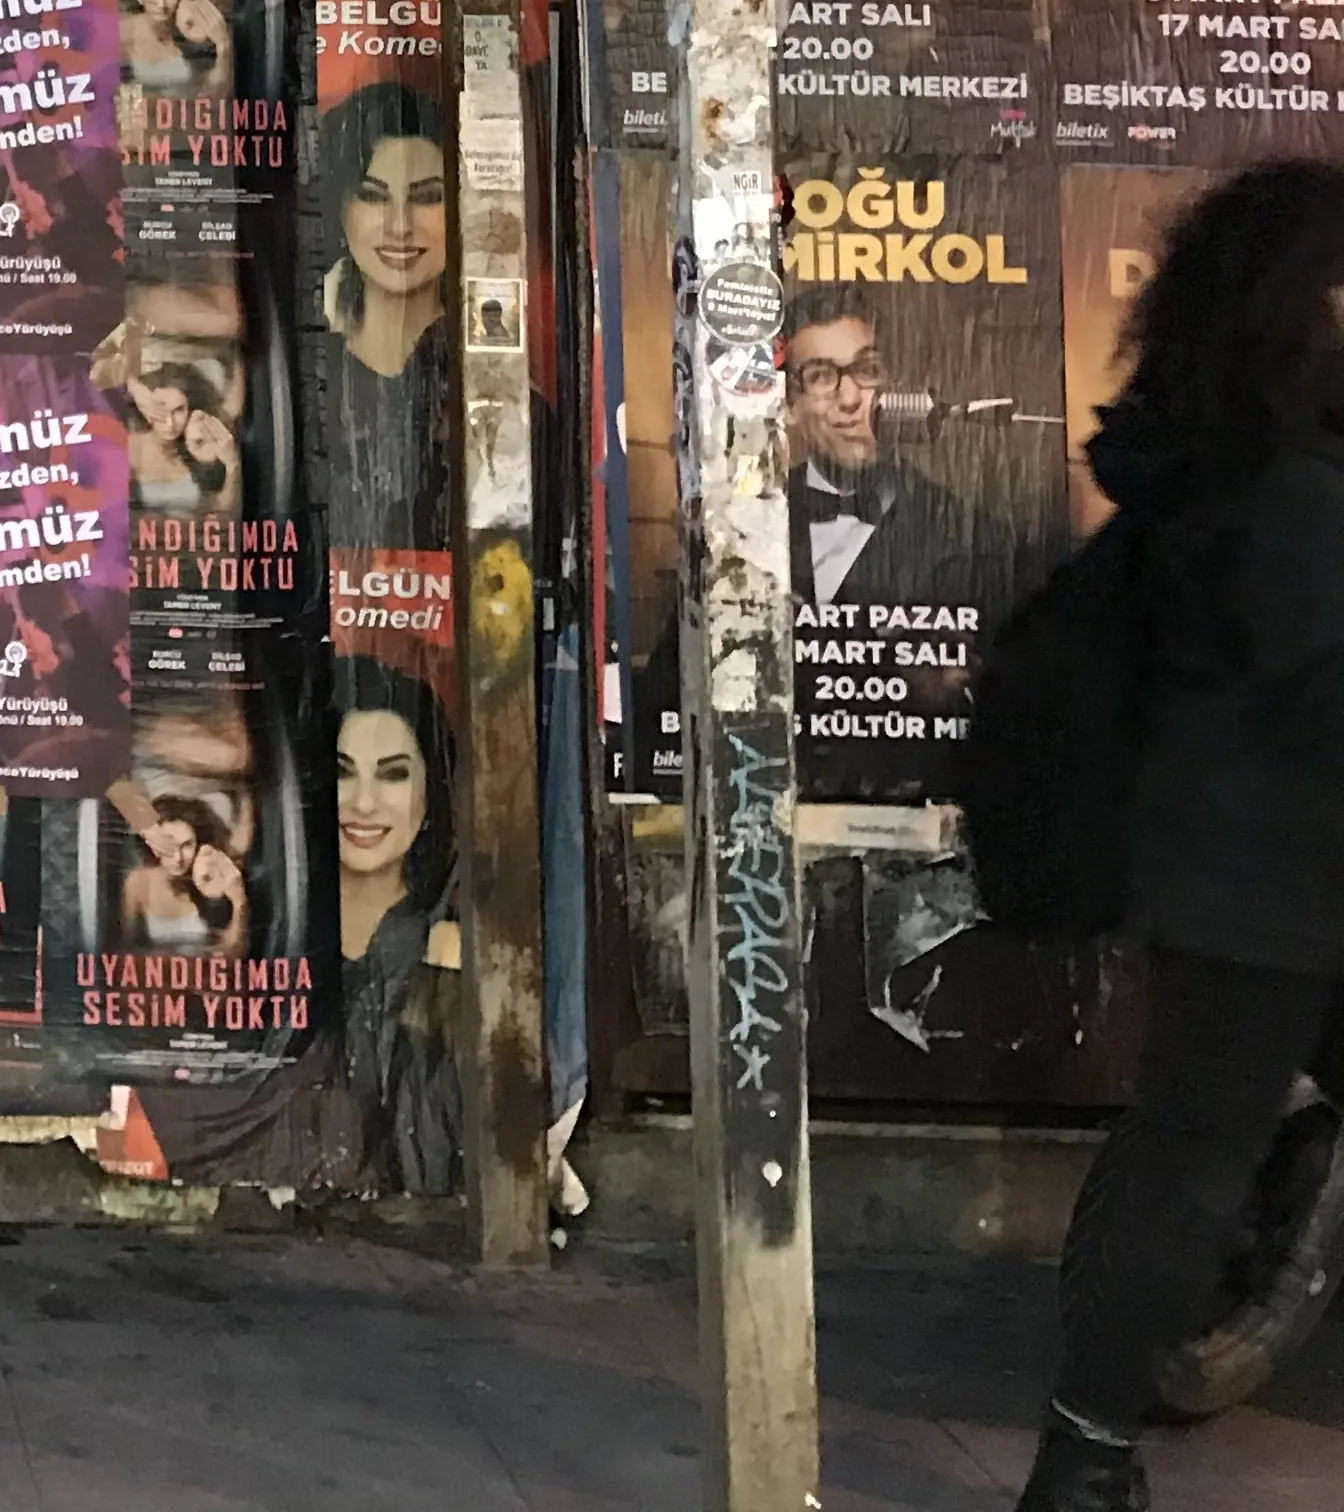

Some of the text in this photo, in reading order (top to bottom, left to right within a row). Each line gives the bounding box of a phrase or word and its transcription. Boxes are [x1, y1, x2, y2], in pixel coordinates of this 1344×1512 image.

[789, 2, 931, 27] ART SALI
[1159, 14, 1344, 41] 17 MART SA
[784, 37, 873, 60] 20.00
[1220, 50, 1311, 76] 20.00
[778, 72, 1027, 98] KÜLTÜR MERKEZİ
[1064, 80, 1329, 111] BEŞİKTAŞ KÜLTÜR
[1056, 121, 1109, 140] biletix
[793, 167, 944, 229] OĞU
[783, 233, 1027, 284] MİRKOL
[129, 514, 298, 552] NDIĞIMDA
[197, 556, 294, 591] YOKTU
[330, 568, 451, 600] LGÜN
[334, 605, 443, 631] omedi
[794, 604, 979, 631] ART PAZAR
[795, 641, 966, 667] MART SALI
[815, 676, 907, 702] 20.00
[811, 709, 925, 739] KÜLTÜR
[77, 952, 312, 992] UYANDIĞIMDA
[202, 994, 309, 1031] YOKTU
